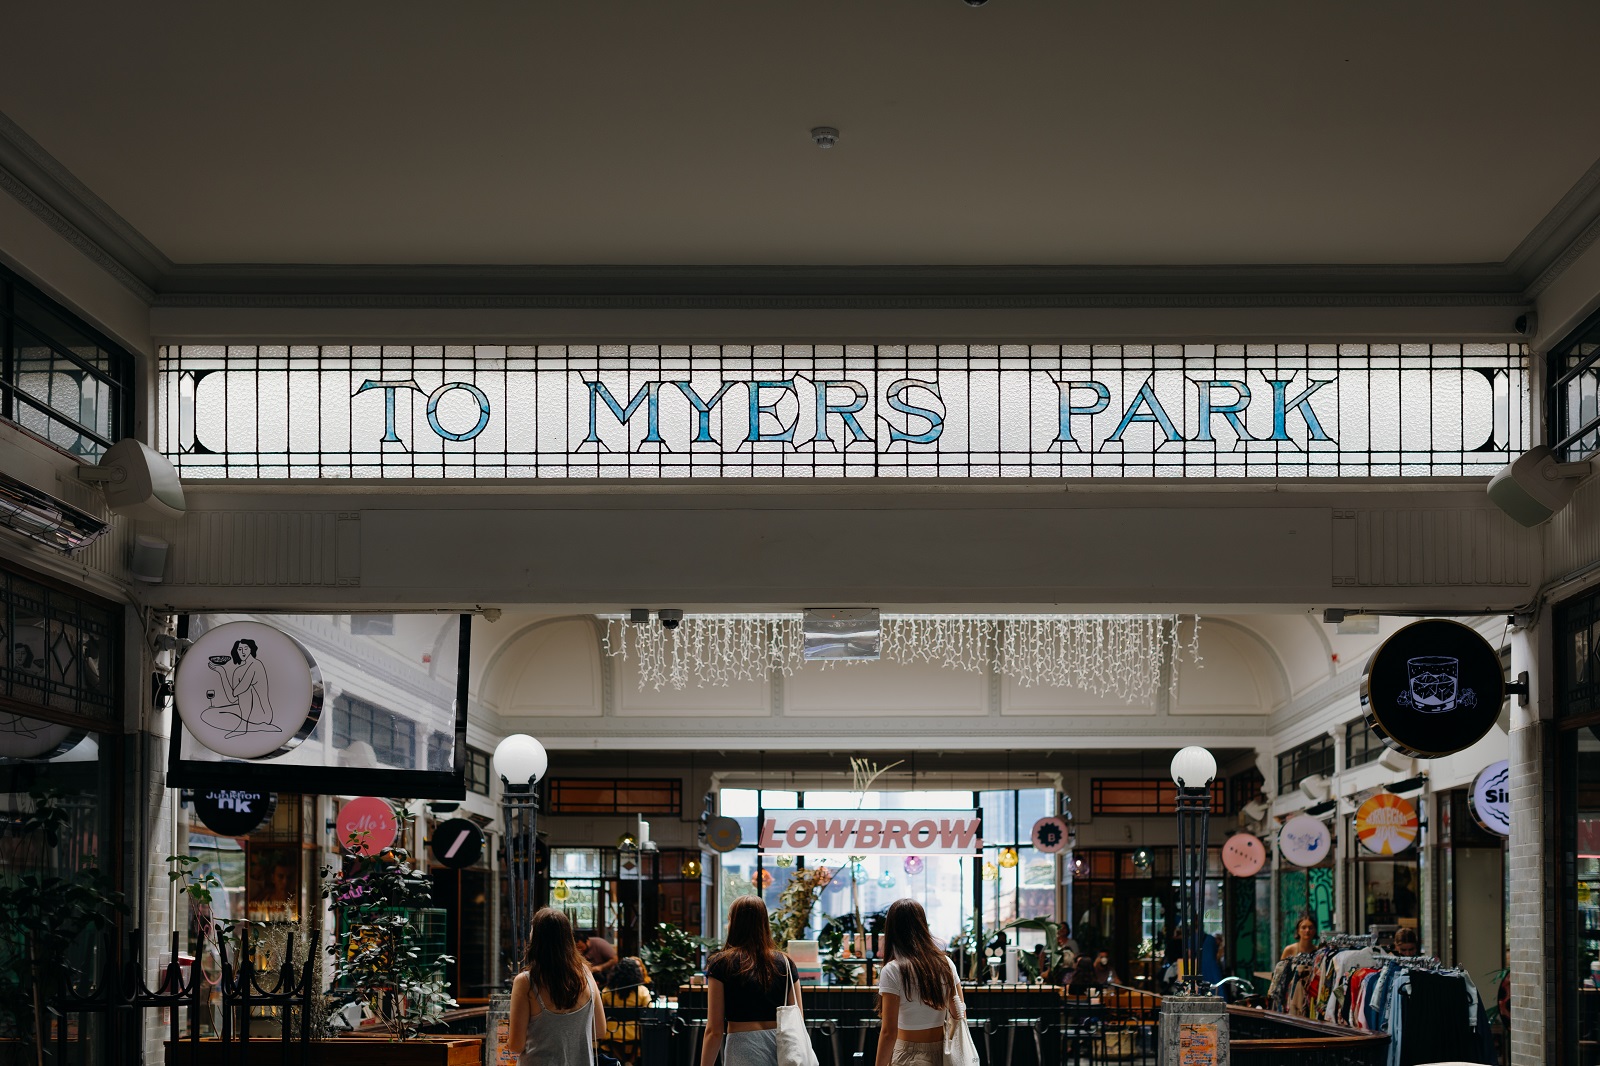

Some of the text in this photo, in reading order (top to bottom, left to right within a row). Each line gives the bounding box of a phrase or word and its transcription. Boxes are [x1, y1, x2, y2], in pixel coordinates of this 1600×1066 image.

[351, 378, 1337, 445] TO MYERS PARK
[345, 814, 387, 832] Mo's
[1047, 833, 1056, 842] B
